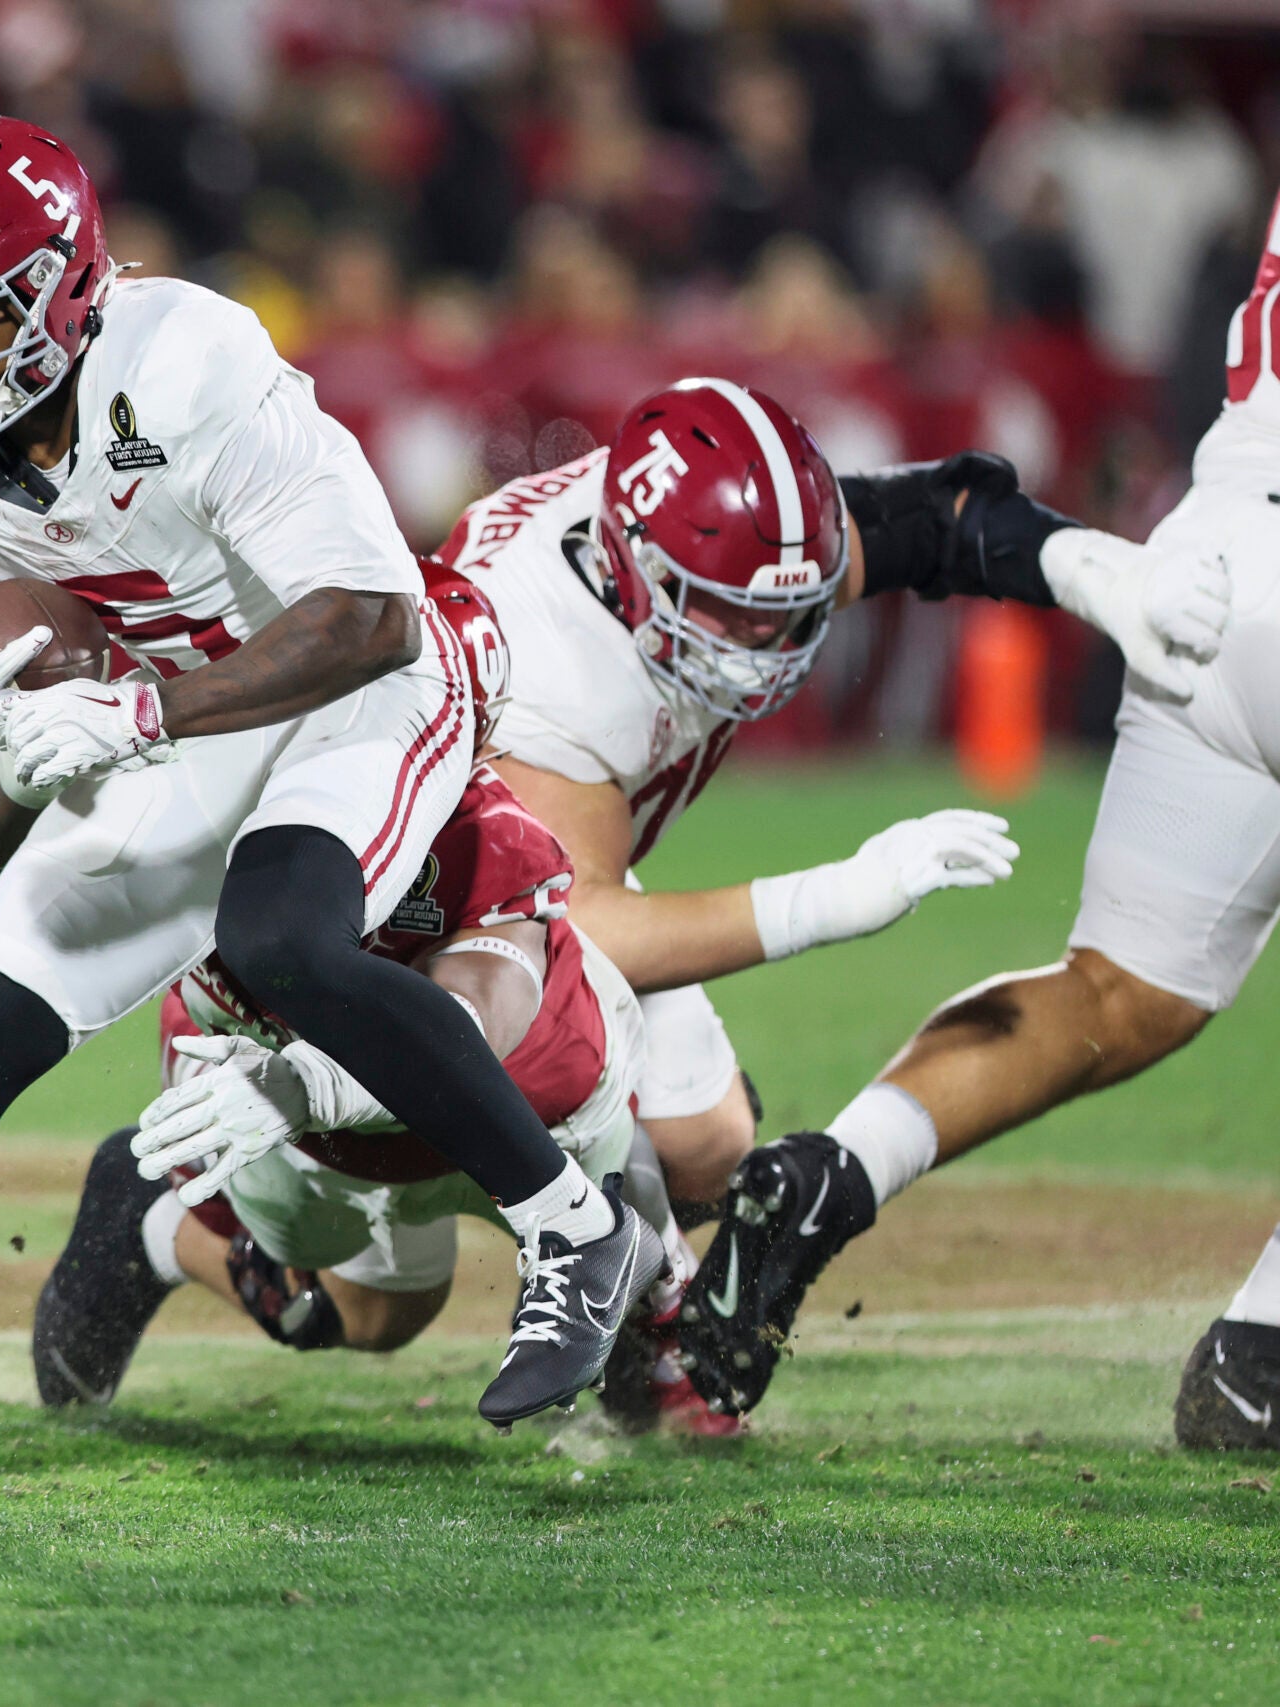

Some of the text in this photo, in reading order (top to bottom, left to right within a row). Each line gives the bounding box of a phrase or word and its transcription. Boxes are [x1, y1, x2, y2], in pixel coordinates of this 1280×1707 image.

[7, 155, 70, 221] 5
[108, 447, 162, 462] FIRST ROUND
[114, 440, 148, 452] PLAYOFF
[617, 428, 690, 517] 75
[463, 465, 592, 570] RMBY
[773, 571, 808, 588] BAMA
